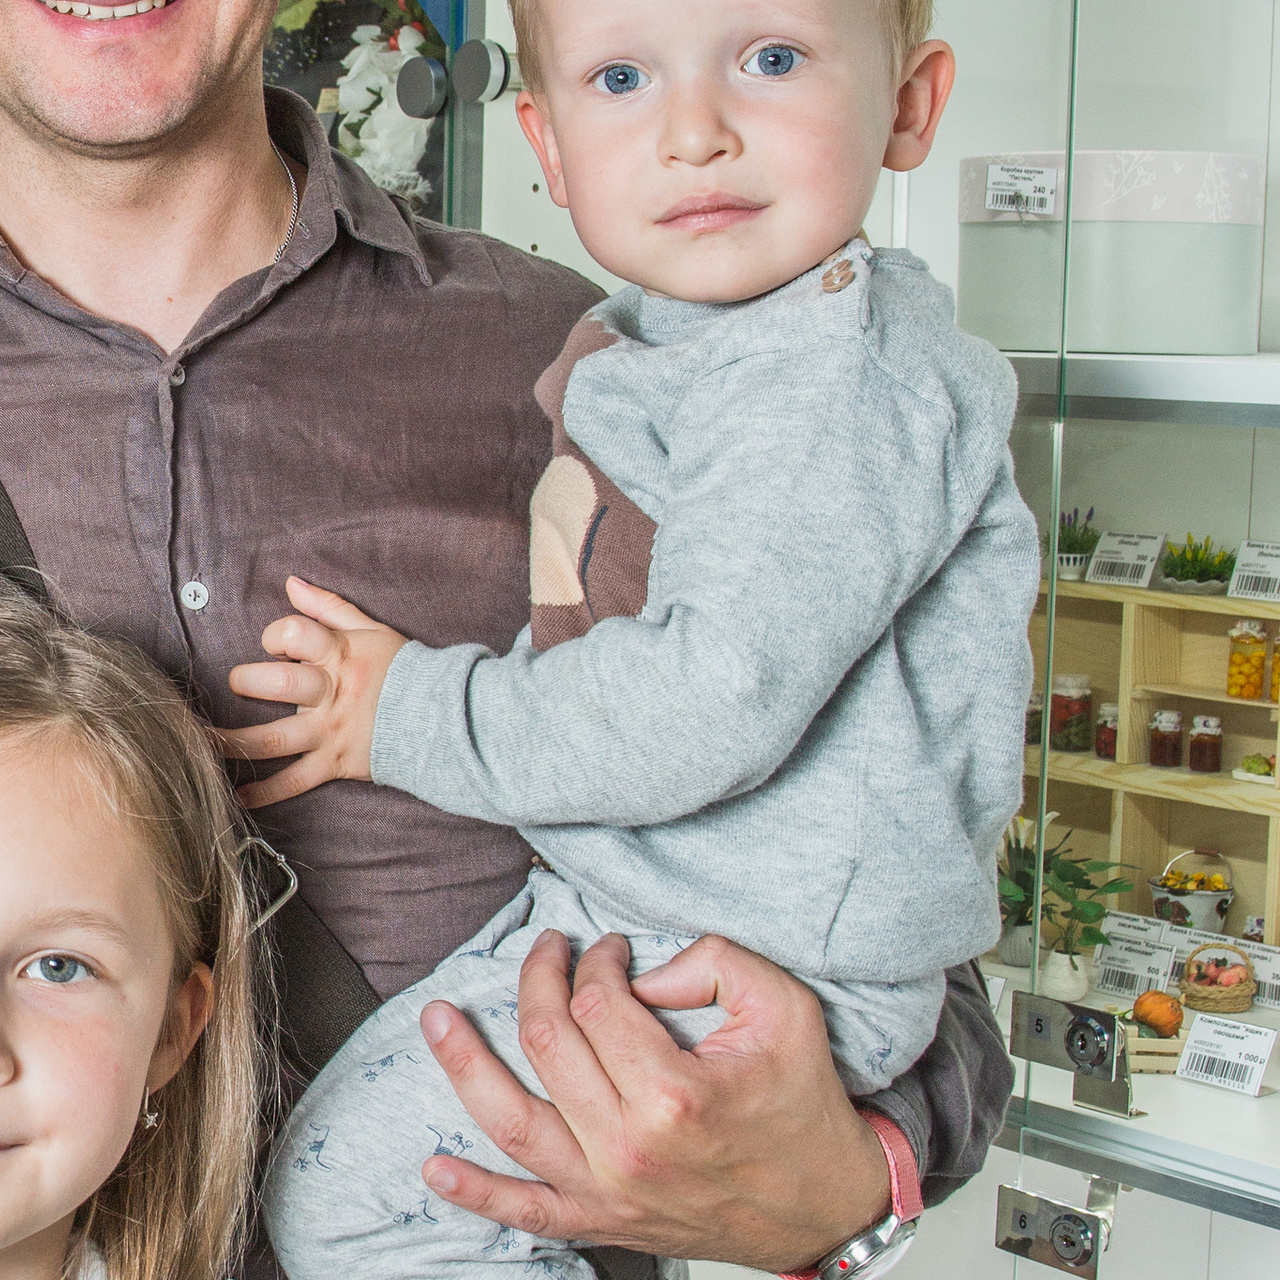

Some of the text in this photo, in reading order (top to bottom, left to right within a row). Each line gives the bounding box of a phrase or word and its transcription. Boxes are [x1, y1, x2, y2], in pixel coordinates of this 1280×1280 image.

[1000, 166, 1044, 176] Коробка круглая
[1033, 185, 1046, 194] 240
[1169, 925, 1188, 935] Банка
[1034, 1018, 1044, 1034] 5
[1199, 1016, 1241, 1030] Композиция
[1213, 1028, 1250, 1041] овощами"
[1018, 1214, 1028, 1230] 6
